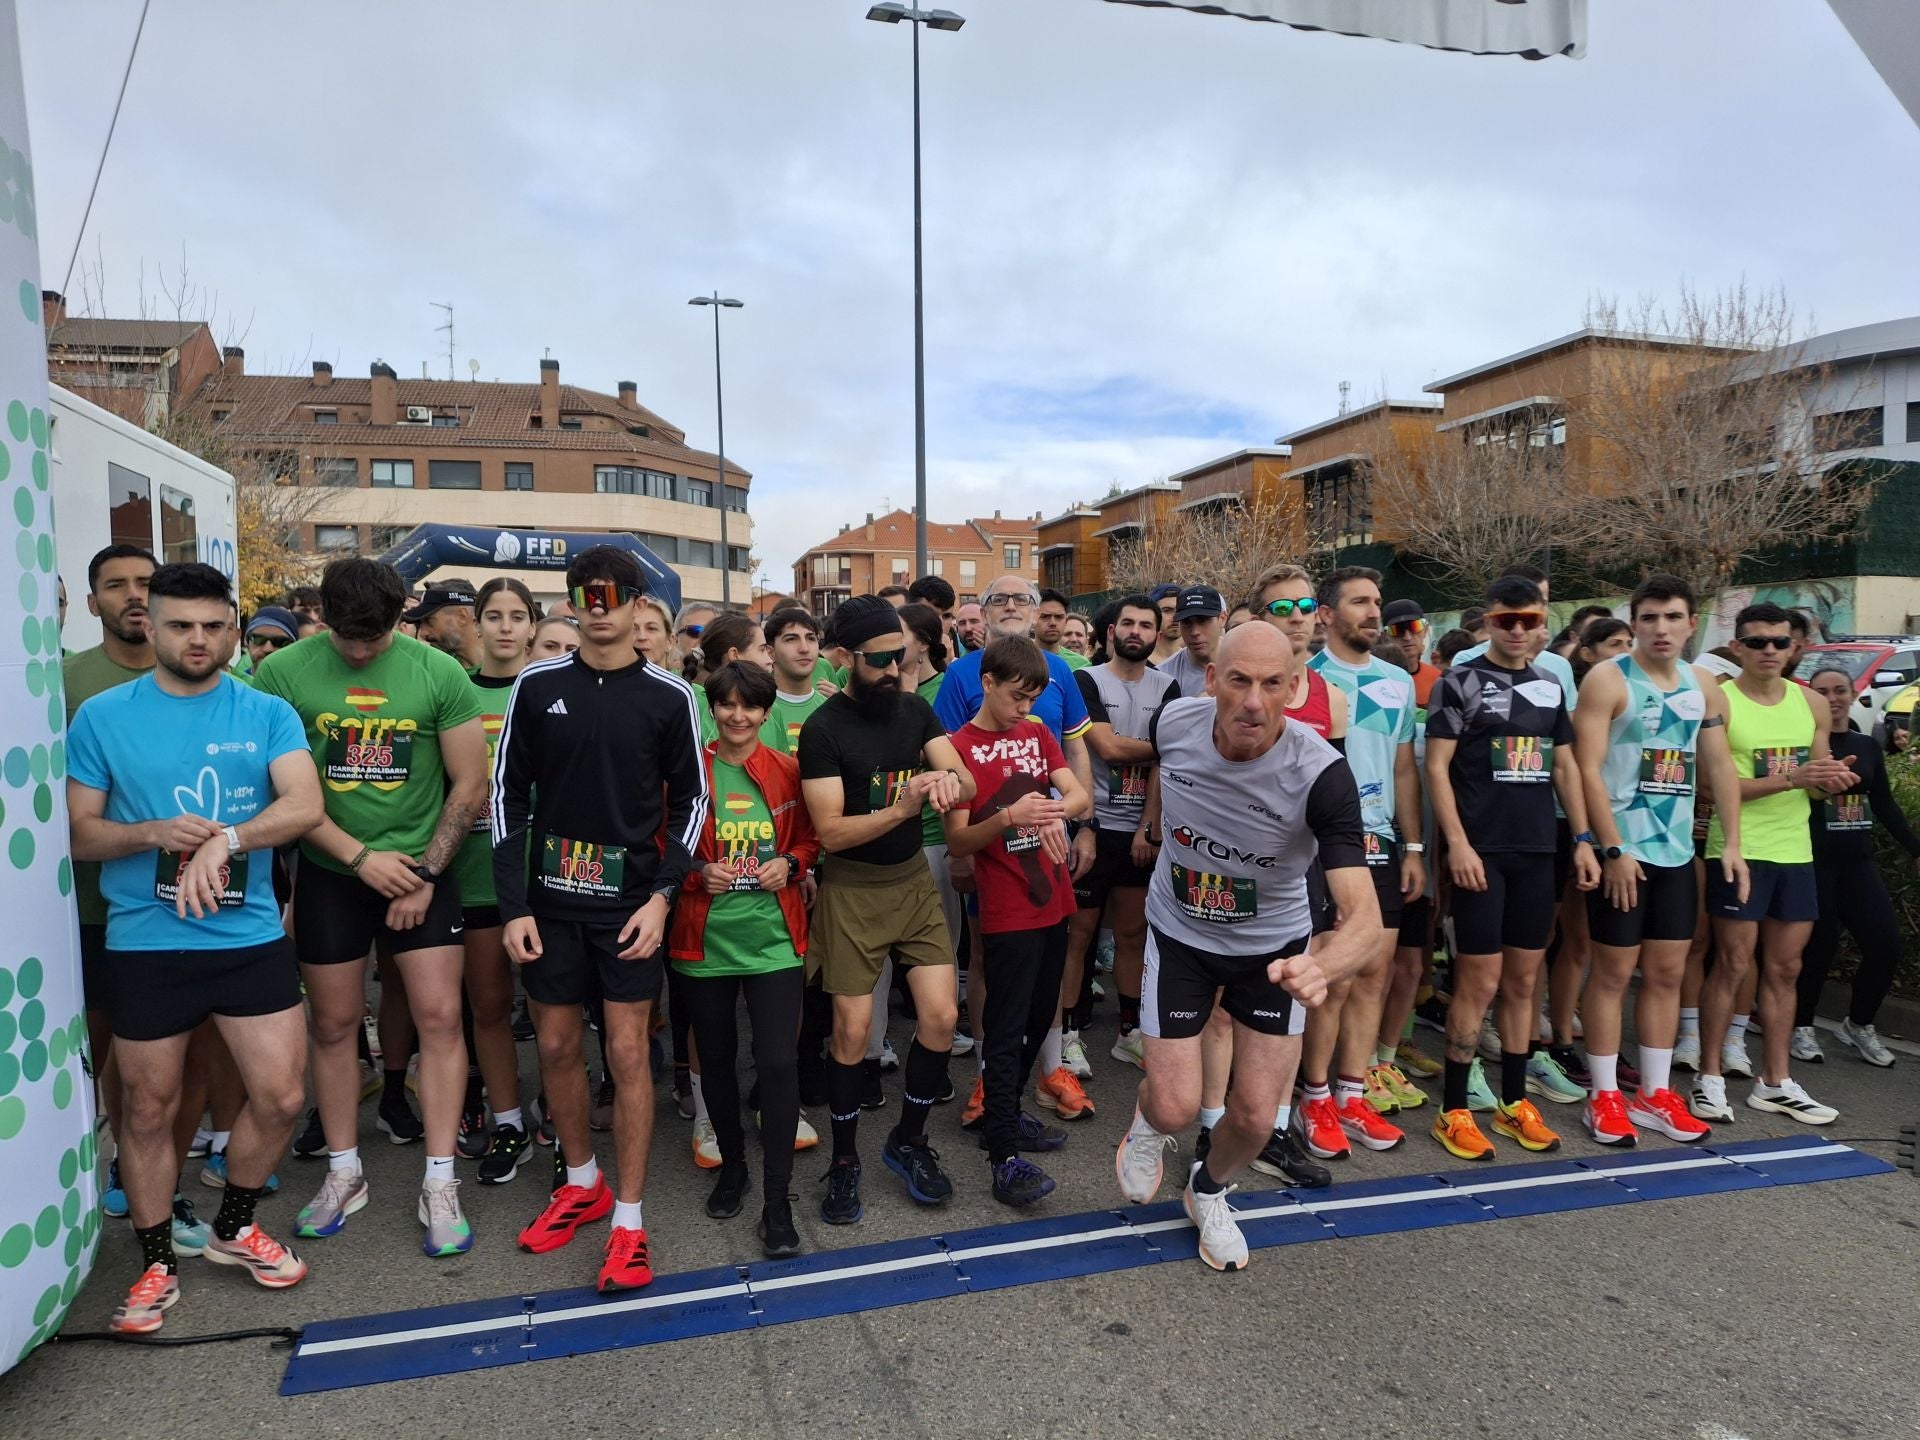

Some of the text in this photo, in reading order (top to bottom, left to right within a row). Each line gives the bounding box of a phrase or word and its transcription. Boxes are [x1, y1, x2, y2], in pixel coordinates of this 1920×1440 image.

[526, 537, 567, 555] FFD
[346, 744, 393, 767] 325
[1507, 750, 1543, 771] 110
[331, 765, 408, 774] CARRERA SOLIDARIA
[1653, 763, 1686, 783] 310
[561, 857, 603, 884] 102
[547, 875, 620, 892] CARRERA SOLIDARIA
[547, 882, 576, 893] GUARDIA
[577, 887, 595, 896] CIVIL
[1188, 886, 1237, 911] 196
[1209, 914, 1228, 922] CIVIL
[1210, 908, 1255, 917] SOLIDARIA
